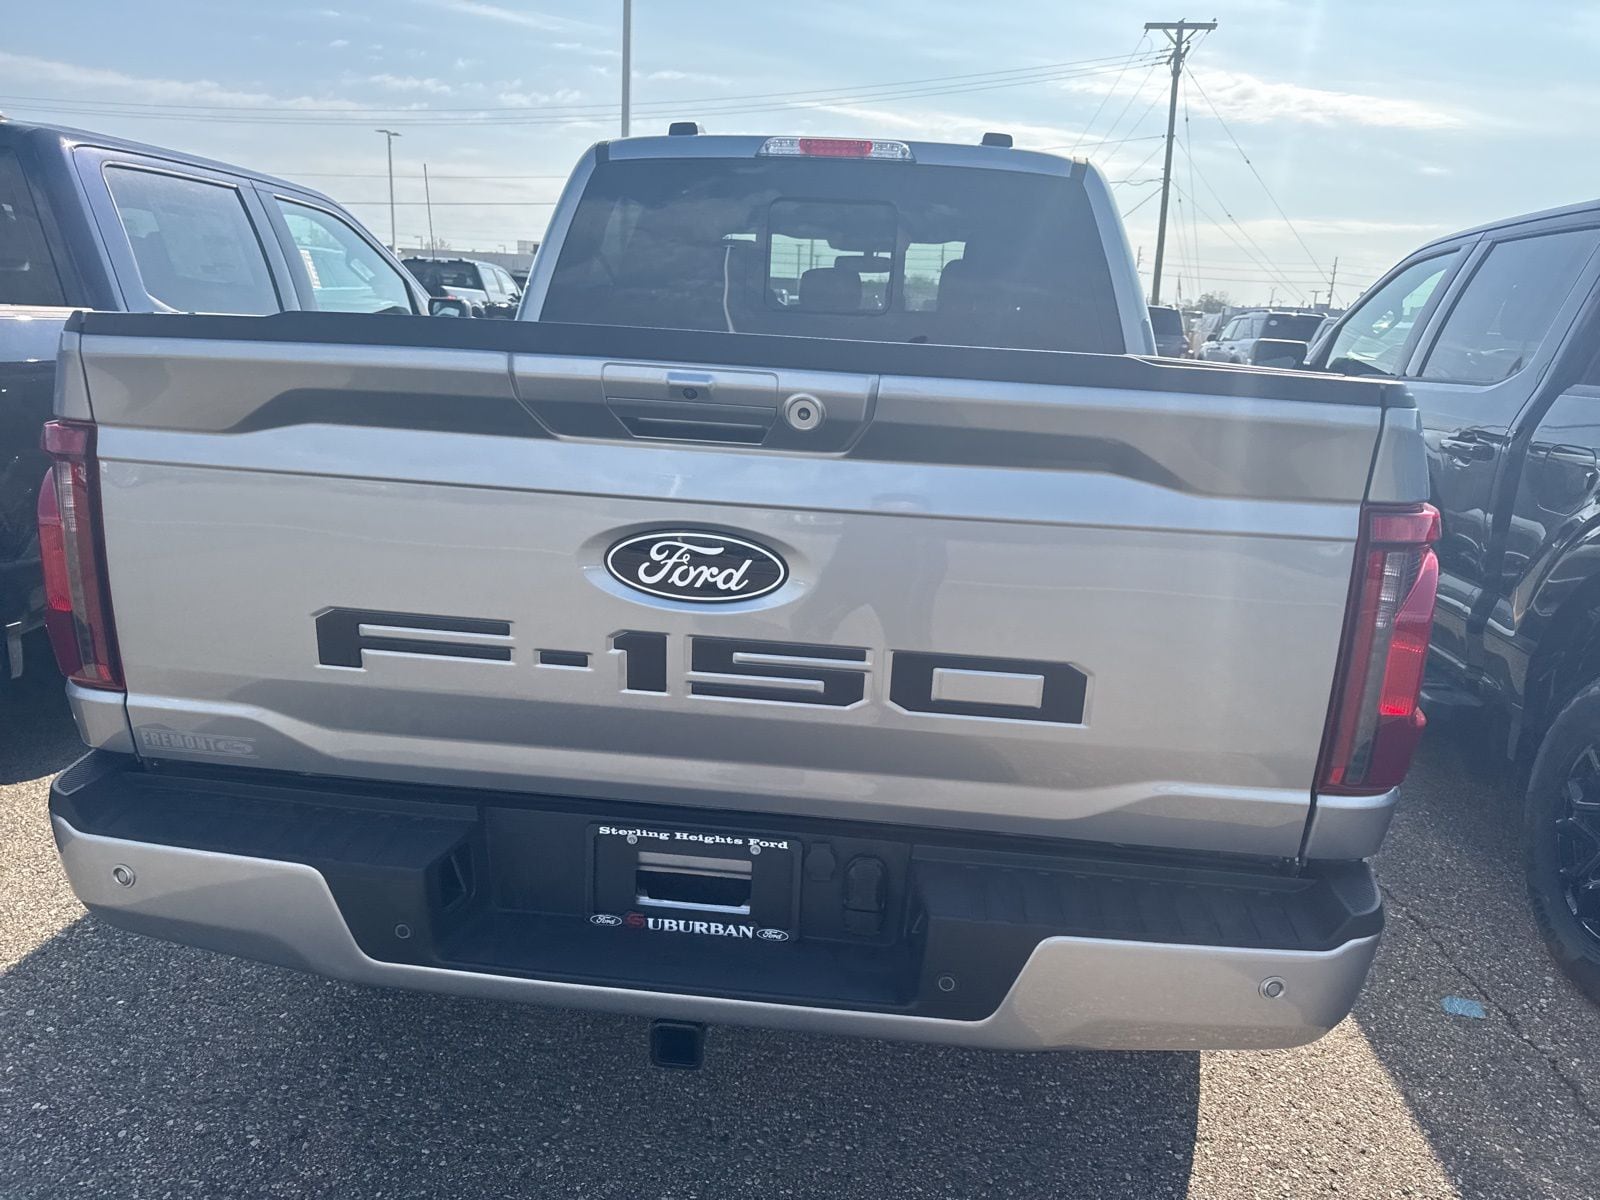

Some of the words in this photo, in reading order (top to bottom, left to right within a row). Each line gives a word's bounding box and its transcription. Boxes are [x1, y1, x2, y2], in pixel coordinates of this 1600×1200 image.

[637, 541, 752, 591] Ford
[315, 607, 1088, 727] F-150
[599, 826, 670, 840] Sterling
[675, 832, 743, 845] Heights
[748, 838, 789, 850] Ford
[626, 911, 755, 939] SUBURBAN
